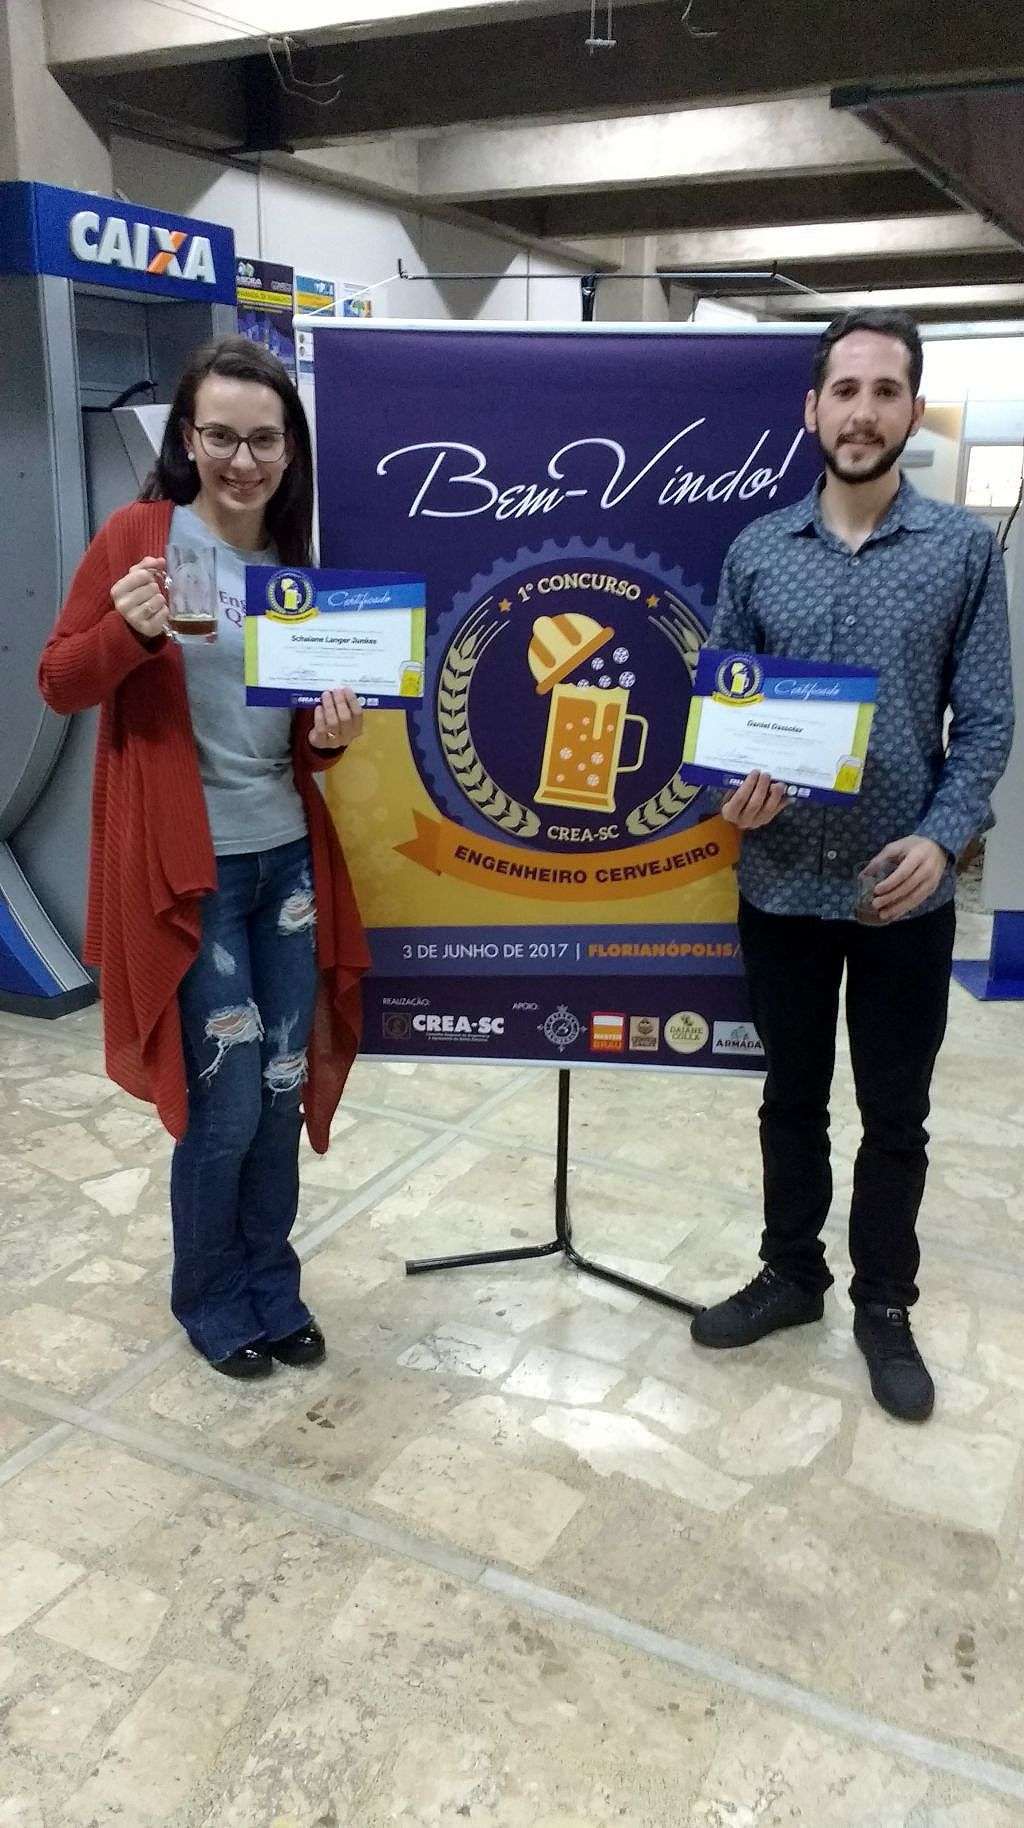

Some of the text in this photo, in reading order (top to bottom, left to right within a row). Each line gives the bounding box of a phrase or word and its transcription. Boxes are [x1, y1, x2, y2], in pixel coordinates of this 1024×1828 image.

[69, 210, 217, 285] CAIXA
[537, 572, 642, 601] CONCURSO
[547, 824, 620, 843] CREA-SC
[454, 841, 721, 884] ENGENHEIRO CERVEJEIRO
[402, 944, 413, 959] 3
[417, 944, 438, 959] DE
[442, 943, 499, 959] JUNHO
[503, 943, 524, 959] DE
[528, 943, 569, 959] 2017
[412, 1014, 504, 1035] CREA-SC
[716, 1040, 762, 1049] ARMADA
